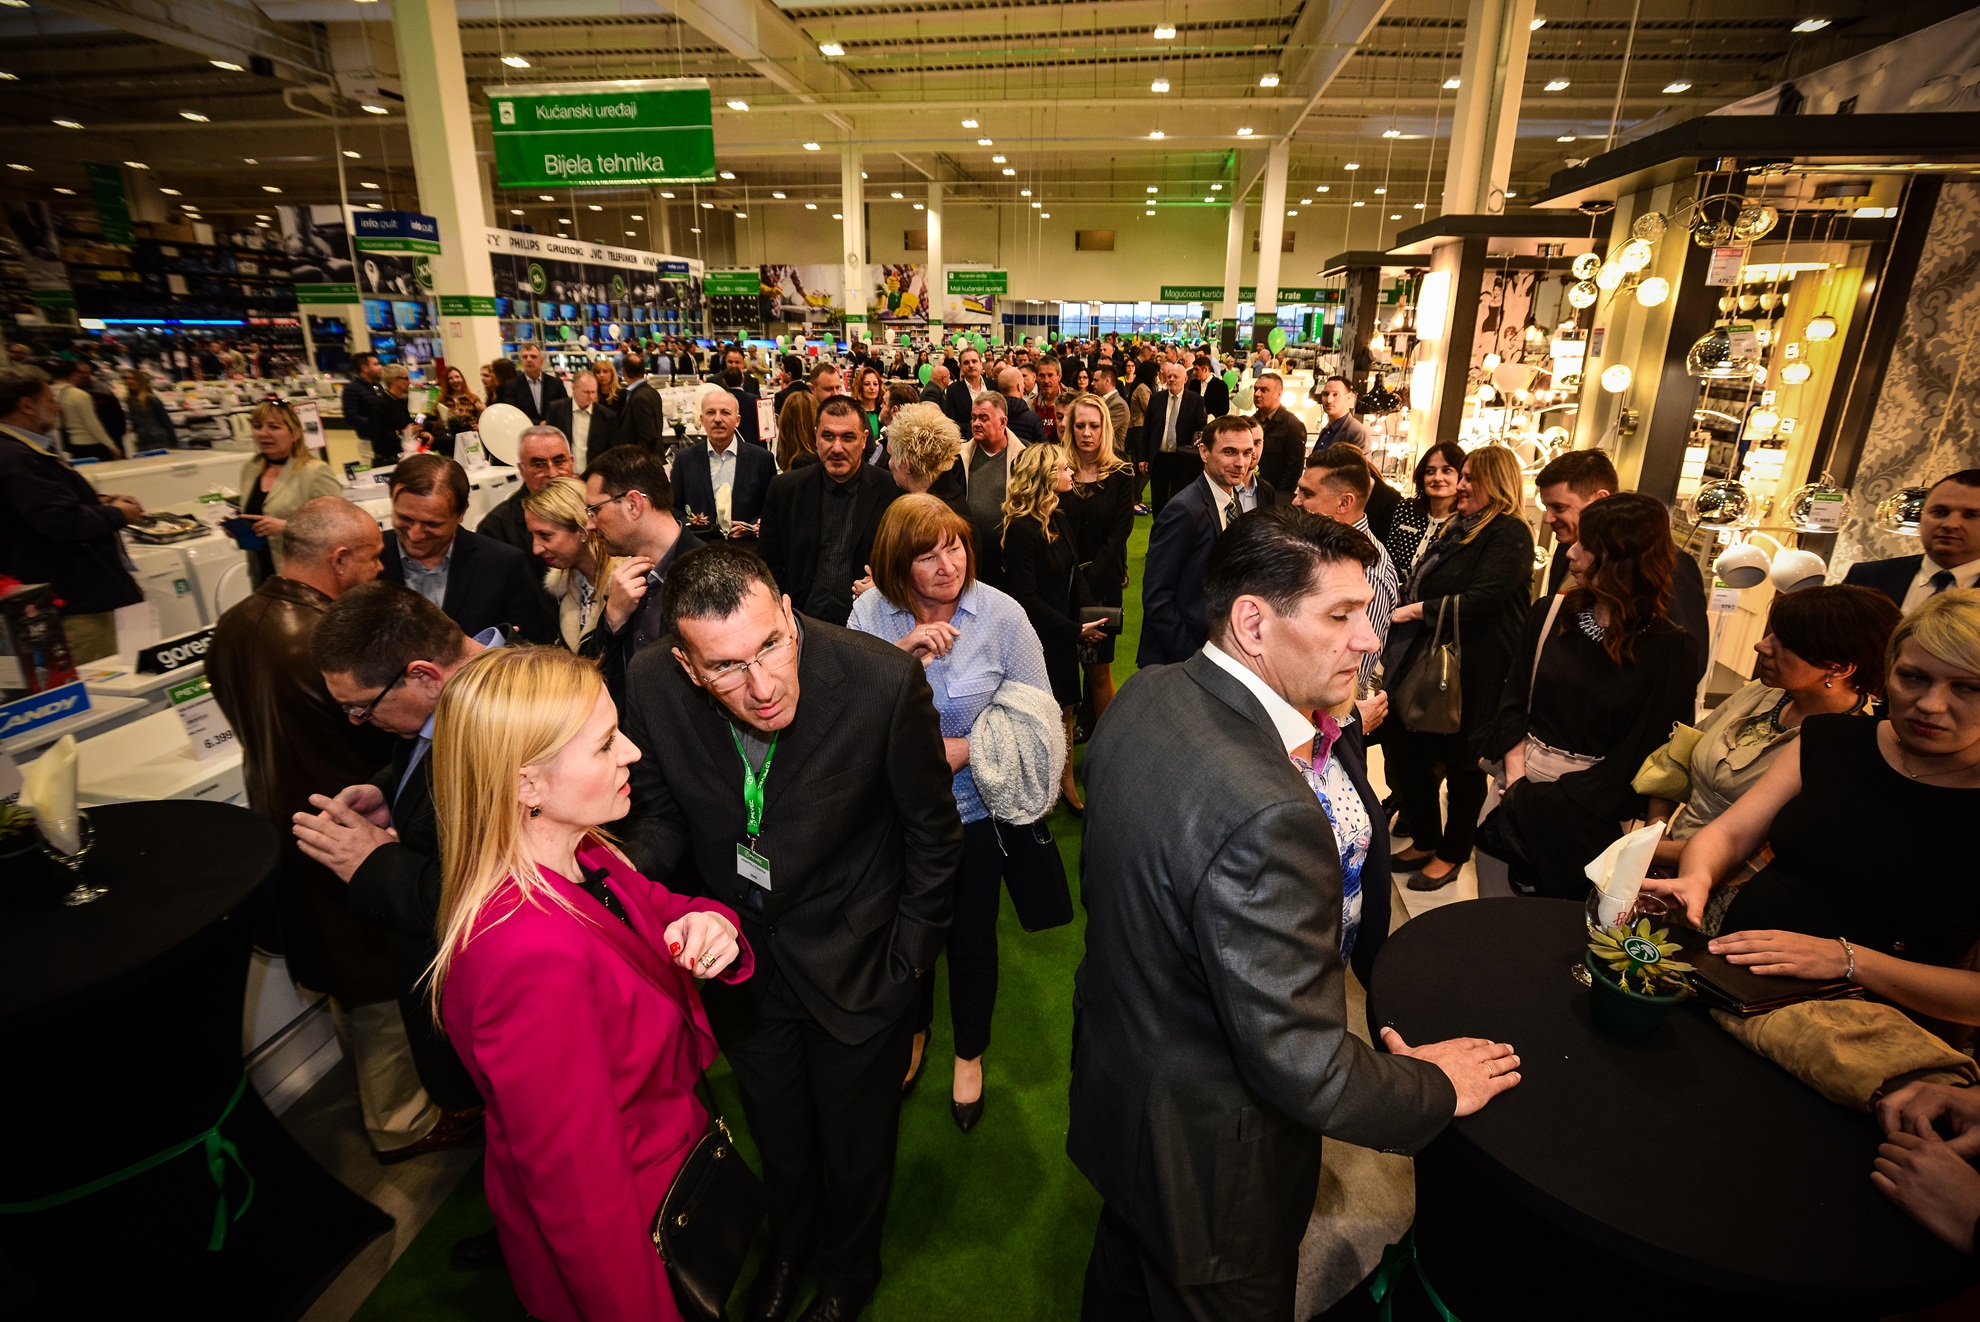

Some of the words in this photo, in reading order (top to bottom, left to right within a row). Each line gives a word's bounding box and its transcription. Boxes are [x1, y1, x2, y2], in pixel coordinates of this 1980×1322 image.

[536, 103, 593, 119] Kućanski
[595, 102, 638, 119] uređaji
[545, 154, 593, 178] Bijela
[597, 152, 665, 173] tehnika
[360, 218, 379, 228] info
[410, 220, 422, 231] info
[509, 236, 540, 251] PHILIPS
[547, 243, 584, 256] GRUNDIG
[590, 249, 603, 260] JVC
[607, 250, 638, 264] TELEFUNKEN
[1164, 289, 1201, 300] Mogućnost
[1284, 293, 1302, 301] rate
[204, 730, 233, 749] 6.399
